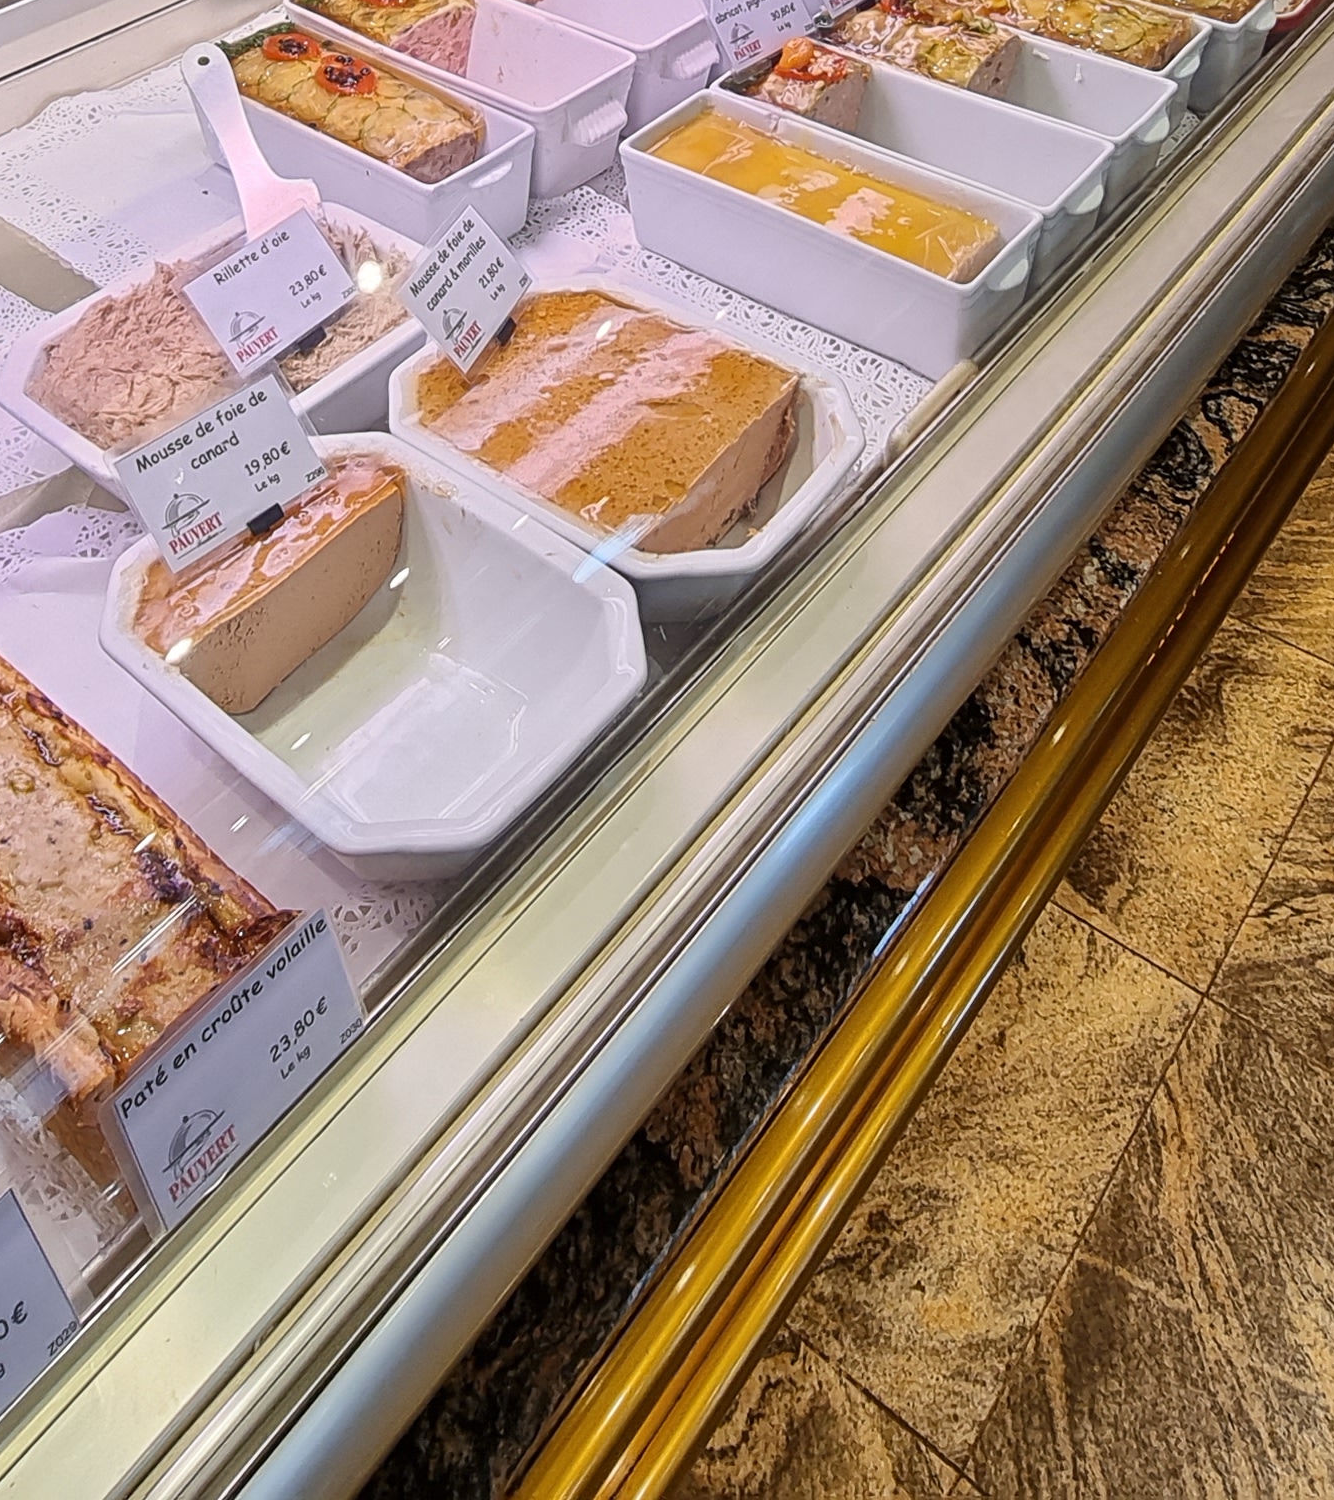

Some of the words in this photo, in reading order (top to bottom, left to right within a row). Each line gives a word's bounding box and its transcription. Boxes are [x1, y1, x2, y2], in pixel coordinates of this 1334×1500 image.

[714, 3, 747, 25] abricot,
[212, 250, 261, 286] Rillette
[408, 261, 441, 298] Mousse
[437, 247, 451, 264] de
[445, 230, 466, 253] foie
[462, 218, 476, 234] de
[426, 274, 454, 312] canard
[456, 235, 487, 275] morilles
[478, 255, 505, 290] 21,80€
[288, 264, 329, 297] 23,80€
[300, 297, 312, 309] Le
[311, 290, 323, 306] kg
[235, 325, 280, 363] PAUVERT
[135, 432, 194, 474] Mousse
[194, 419, 216, 440] de
[215, 402, 248, 428] foie
[247, 388, 269, 409] de
[190, 430, 241, 471] canard
[243, 440, 292, 478] 19,80€
[254, 479, 268, 493] Le
[267, 472, 282, 487] kg
[167, 510, 225, 556] PAUVERT
[119, 1065, 169, 1120] Paté
[172, 1042, 198, 1071] en
[200, 978, 265, 1044] croûte
[265, 916, 328, 981] volaille
[268, 994, 330, 1064] 23,80€
[278, 1061, 296, 1080] Le
[295, 1044, 313, 1067] kg
[167, 1122, 240, 1204] PAUVERT
